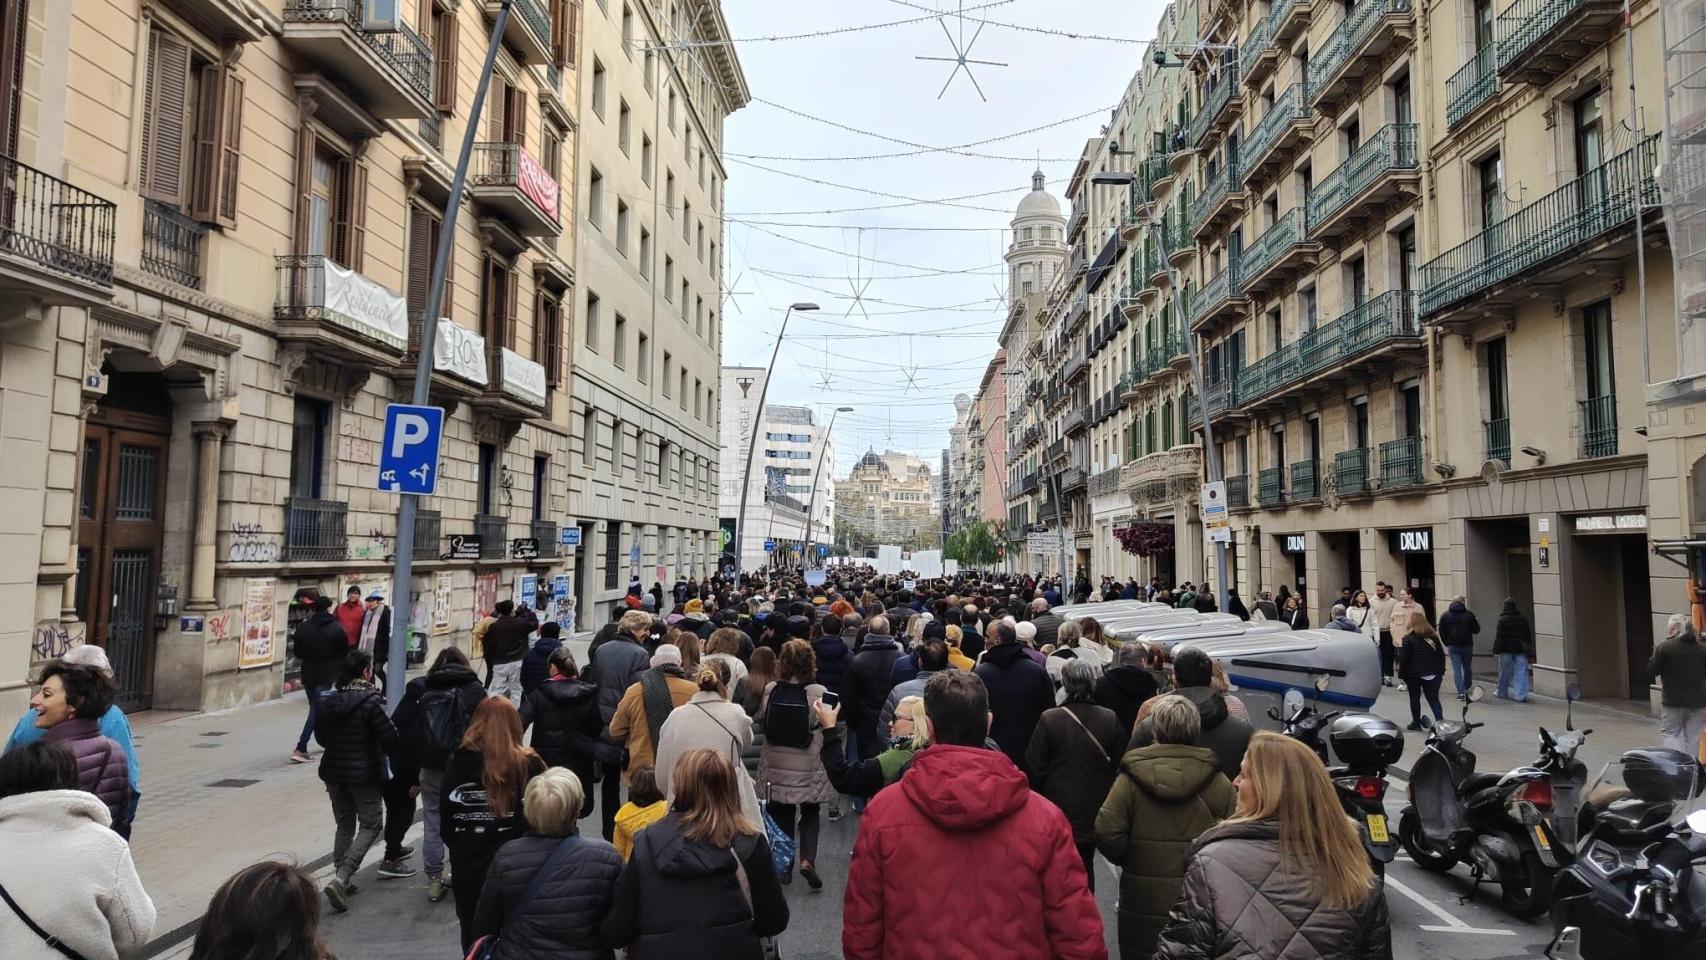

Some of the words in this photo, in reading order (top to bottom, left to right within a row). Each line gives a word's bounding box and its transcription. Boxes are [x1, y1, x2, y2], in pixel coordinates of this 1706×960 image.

[392, 413, 429, 458] P
[1287, 535, 1304, 550] DRUN
[1400, 531, 1429, 550] DRUNI
